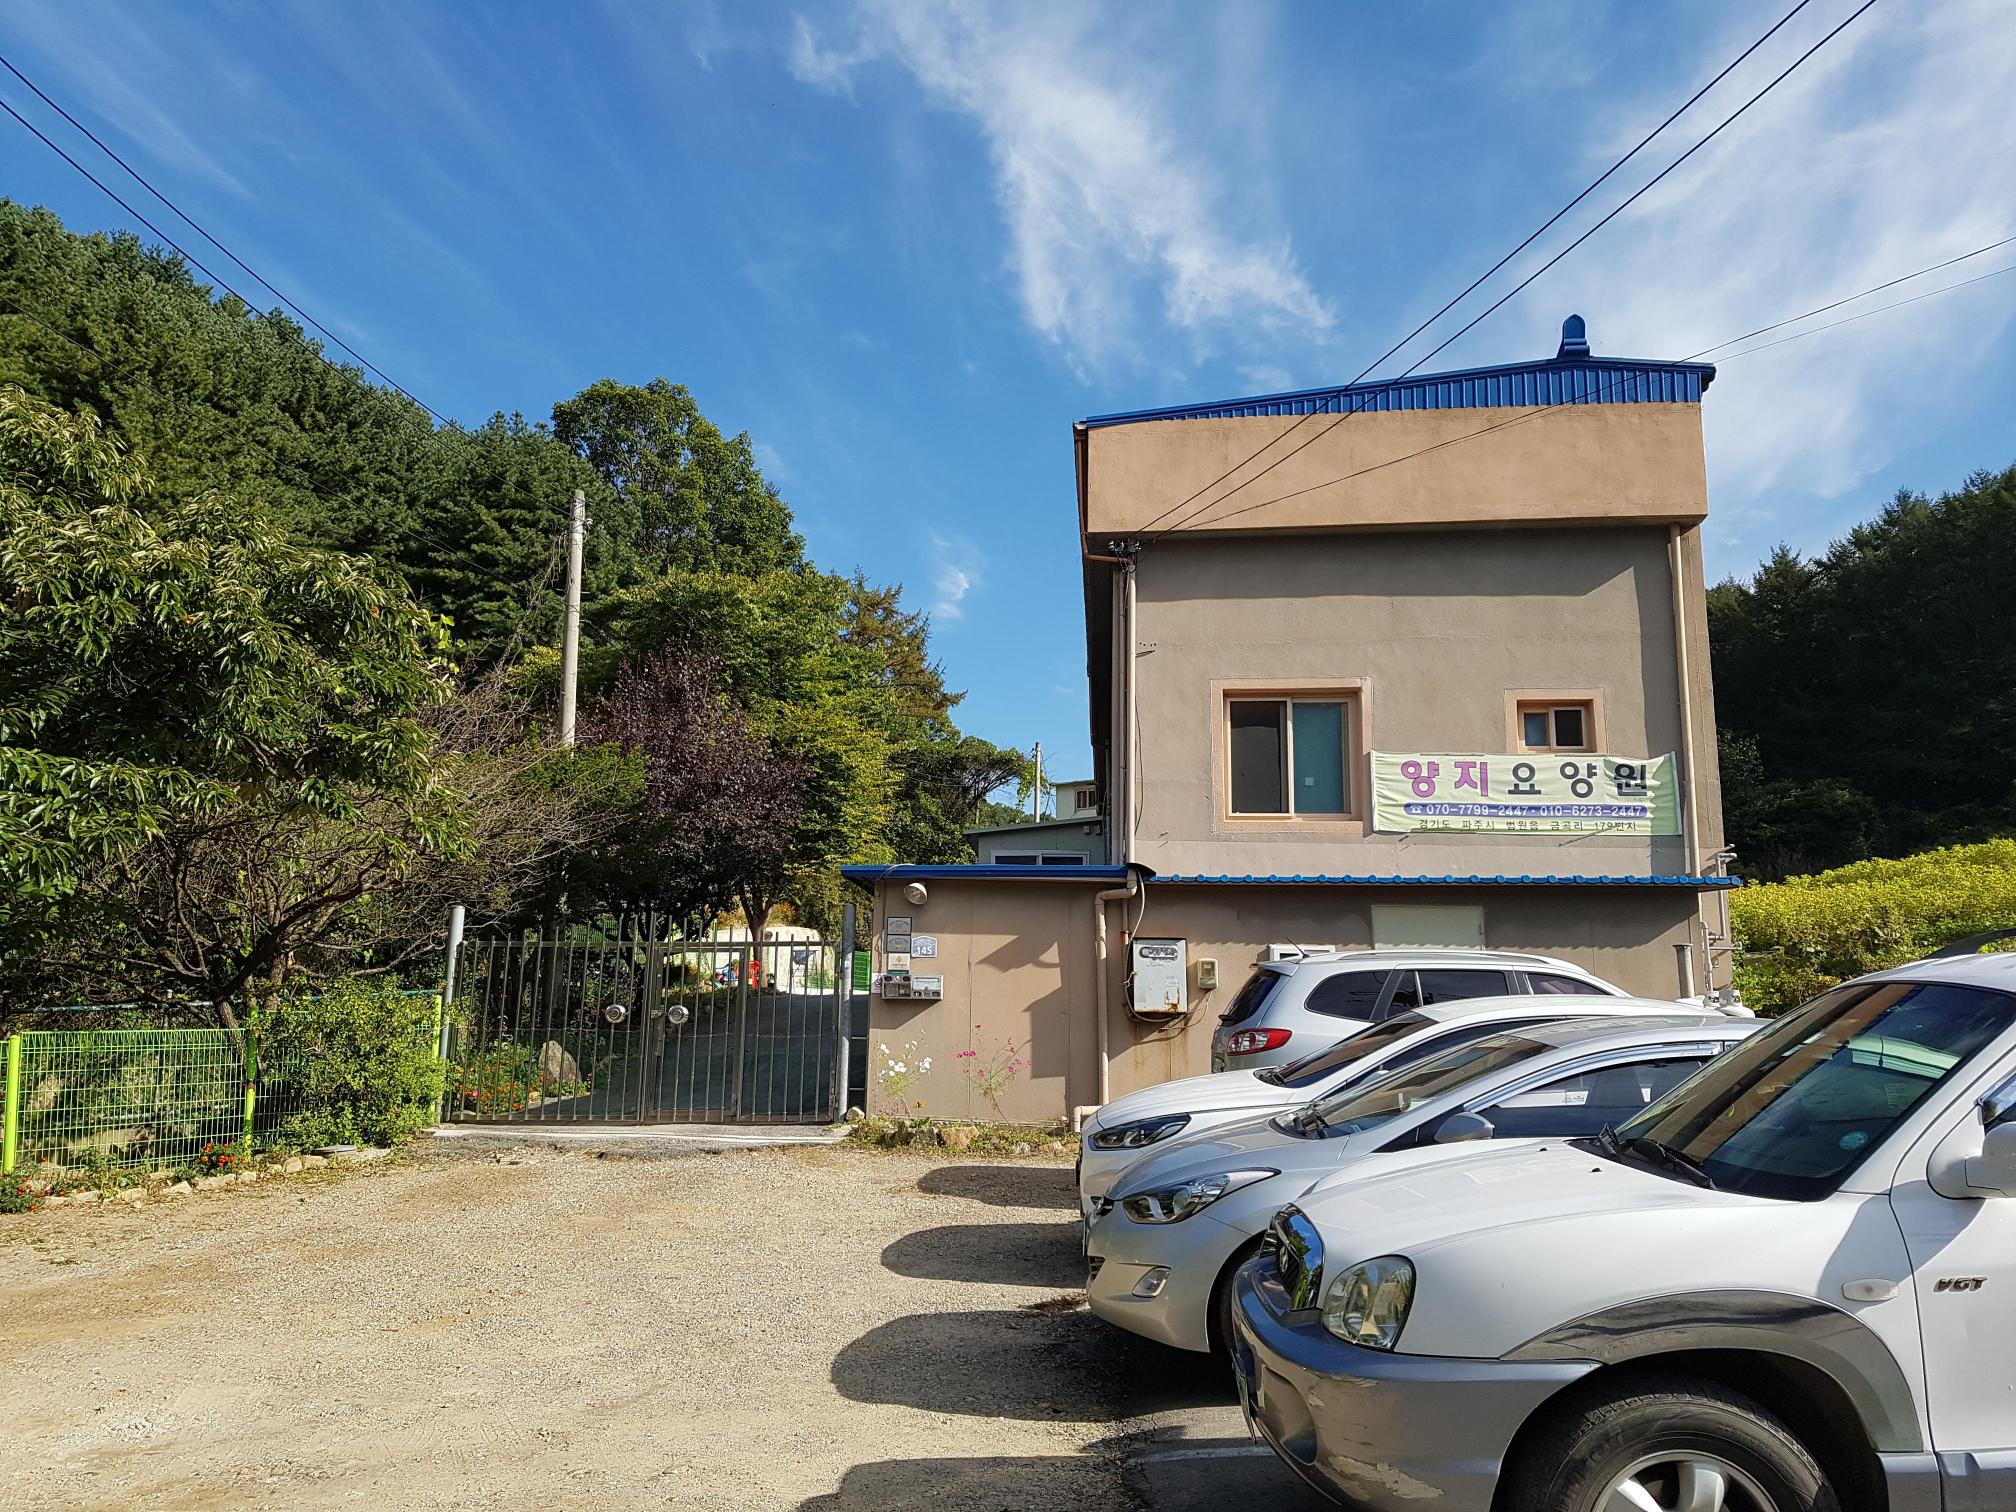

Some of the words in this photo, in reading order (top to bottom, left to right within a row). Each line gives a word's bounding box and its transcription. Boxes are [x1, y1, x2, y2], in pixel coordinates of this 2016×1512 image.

[1426, 803, 1528, 816] 070-7799-2447
[1540, 805, 1641, 817] 010-6273-2447
[1419, 819, 1450, 830] 경기도
[1462, 820, 1495, 830] 파주시
[916, 946, 933, 955] 145
[1933, 1276, 1988, 1292] VGT
